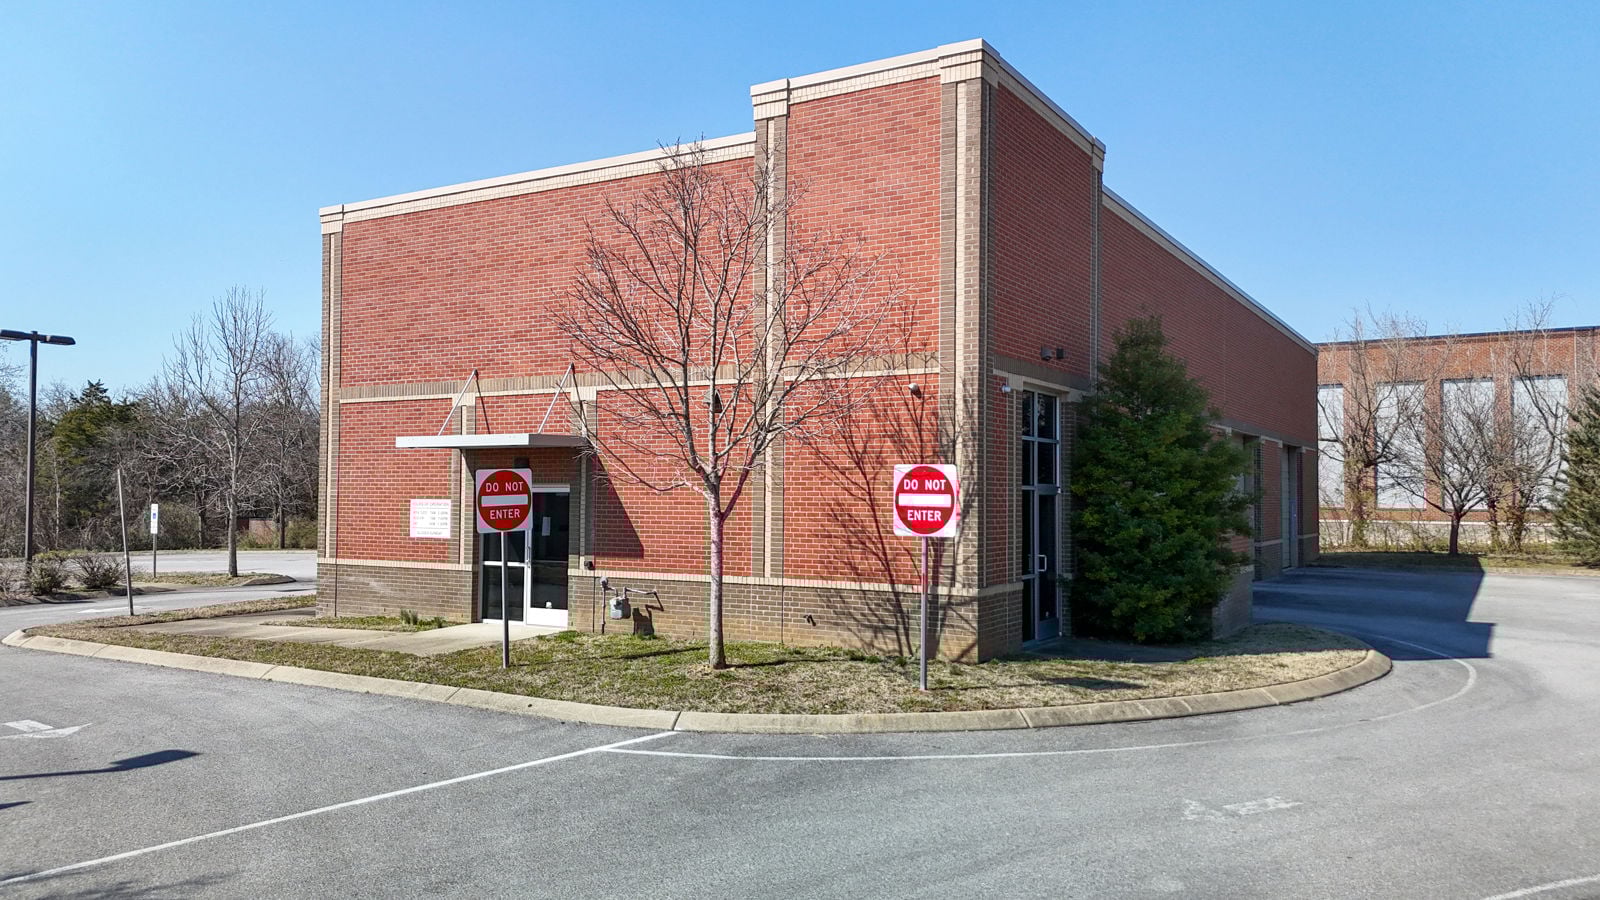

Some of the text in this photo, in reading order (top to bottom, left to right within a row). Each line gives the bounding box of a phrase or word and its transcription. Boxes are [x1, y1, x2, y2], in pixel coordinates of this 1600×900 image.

[485, 481, 524, 492] DO NOT
[903, 479, 946, 491] DO NOT
[489, 508, 521, 520] ENTER
[907, 510, 942, 521] ENTER
